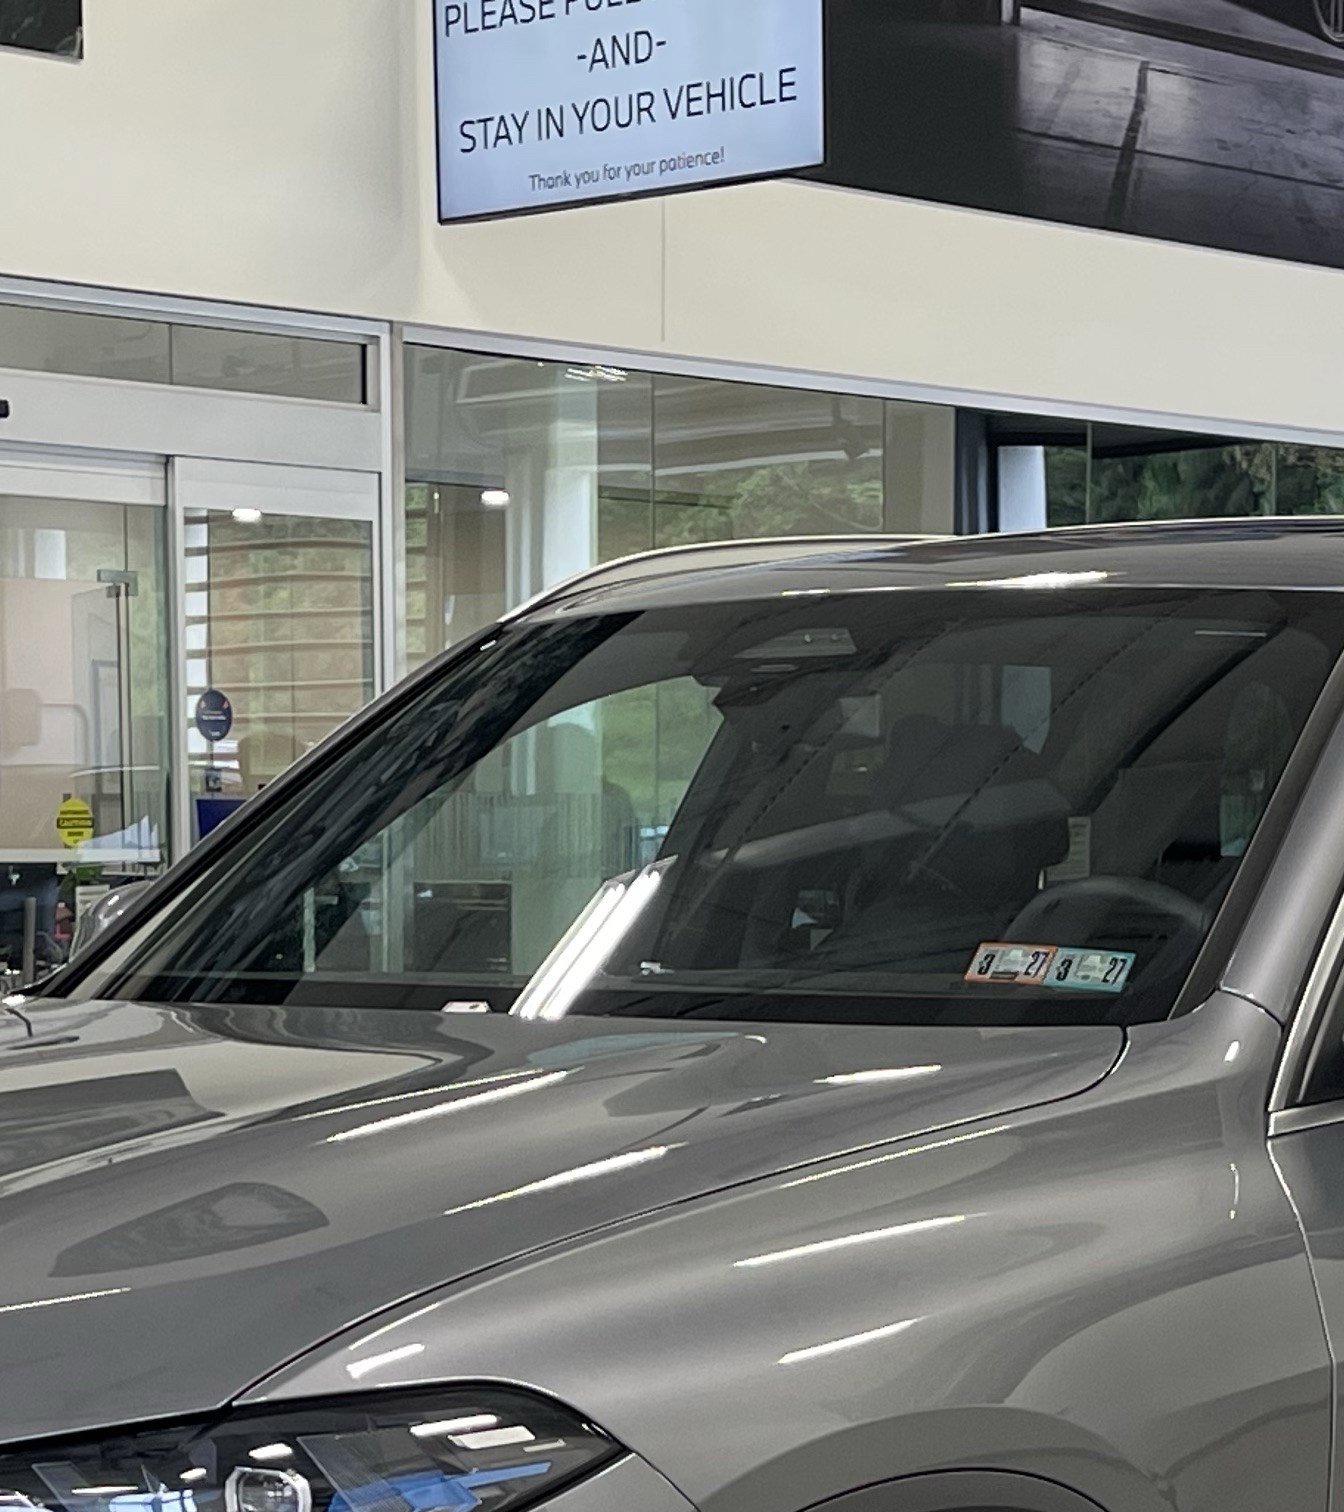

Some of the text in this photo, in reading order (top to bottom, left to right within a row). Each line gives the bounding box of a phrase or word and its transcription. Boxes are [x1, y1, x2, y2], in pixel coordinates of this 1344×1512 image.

[444, 0, 556, 37] PLEASE
[576, 29, 667, 73] -AND-
[459, 66, 798, 154] STAY IN YOUR VEHICLE
[528, 147, 726, 192] Thank you for your patience!
[976, 950, 1050, 978] 3 27
[1056, 957, 1128, 985] 3 27
